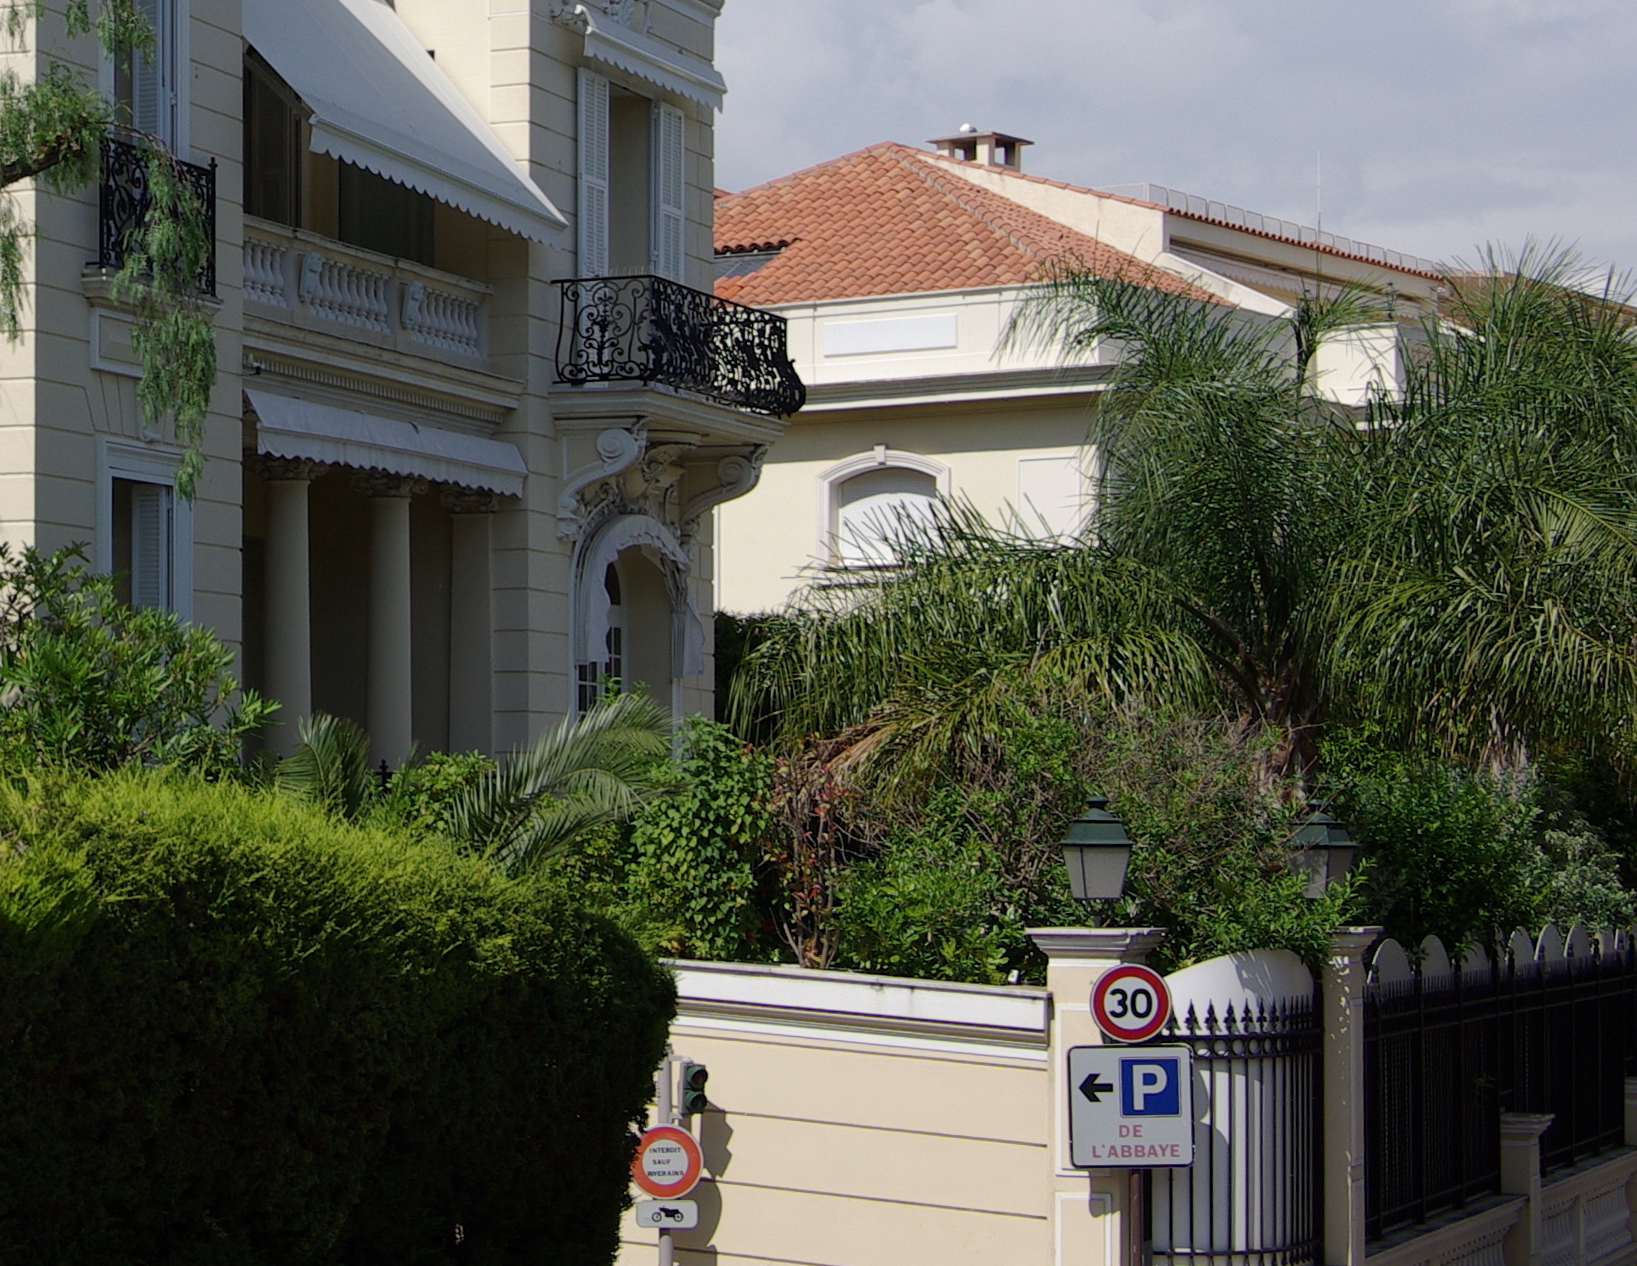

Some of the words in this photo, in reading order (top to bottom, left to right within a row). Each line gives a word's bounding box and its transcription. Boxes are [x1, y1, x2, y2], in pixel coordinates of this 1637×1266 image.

[1109, 988, 1152, 1018] 30
[1132, 1064, 1168, 1111] P
[1118, 1124, 1143, 1138] DE
[1092, 1144, 1181, 1159] L'ABBAYE
